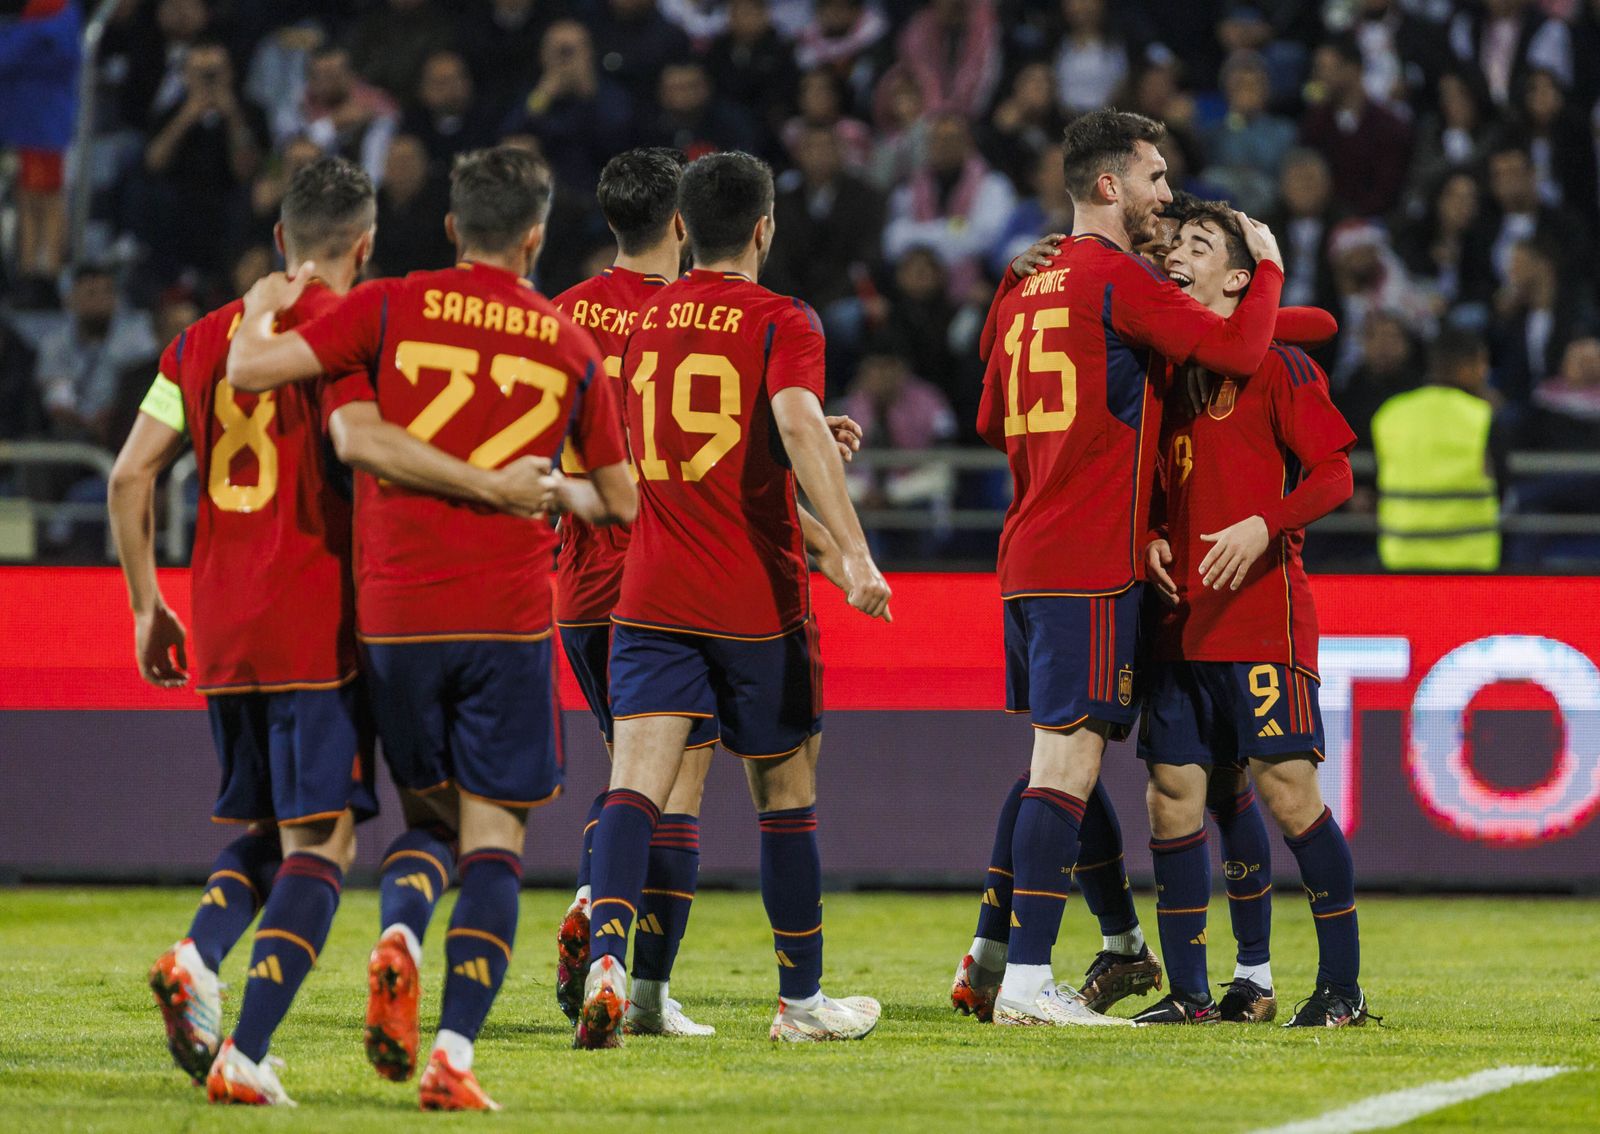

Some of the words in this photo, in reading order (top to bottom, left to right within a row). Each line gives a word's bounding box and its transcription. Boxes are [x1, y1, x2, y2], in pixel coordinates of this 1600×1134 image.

[1021, 268, 1071, 297] LAPORTE
[423, 289, 560, 345] SARABIA
[642, 306, 658, 330] C.
[666, 302, 743, 333] SOLER
[1004, 307, 1077, 437] 15
[208, 375, 279, 513] 8
[631, 351, 742, 482] 19
[1174, 434, 1193, 487] 9
[1248, 663, 1281, 717] 9
